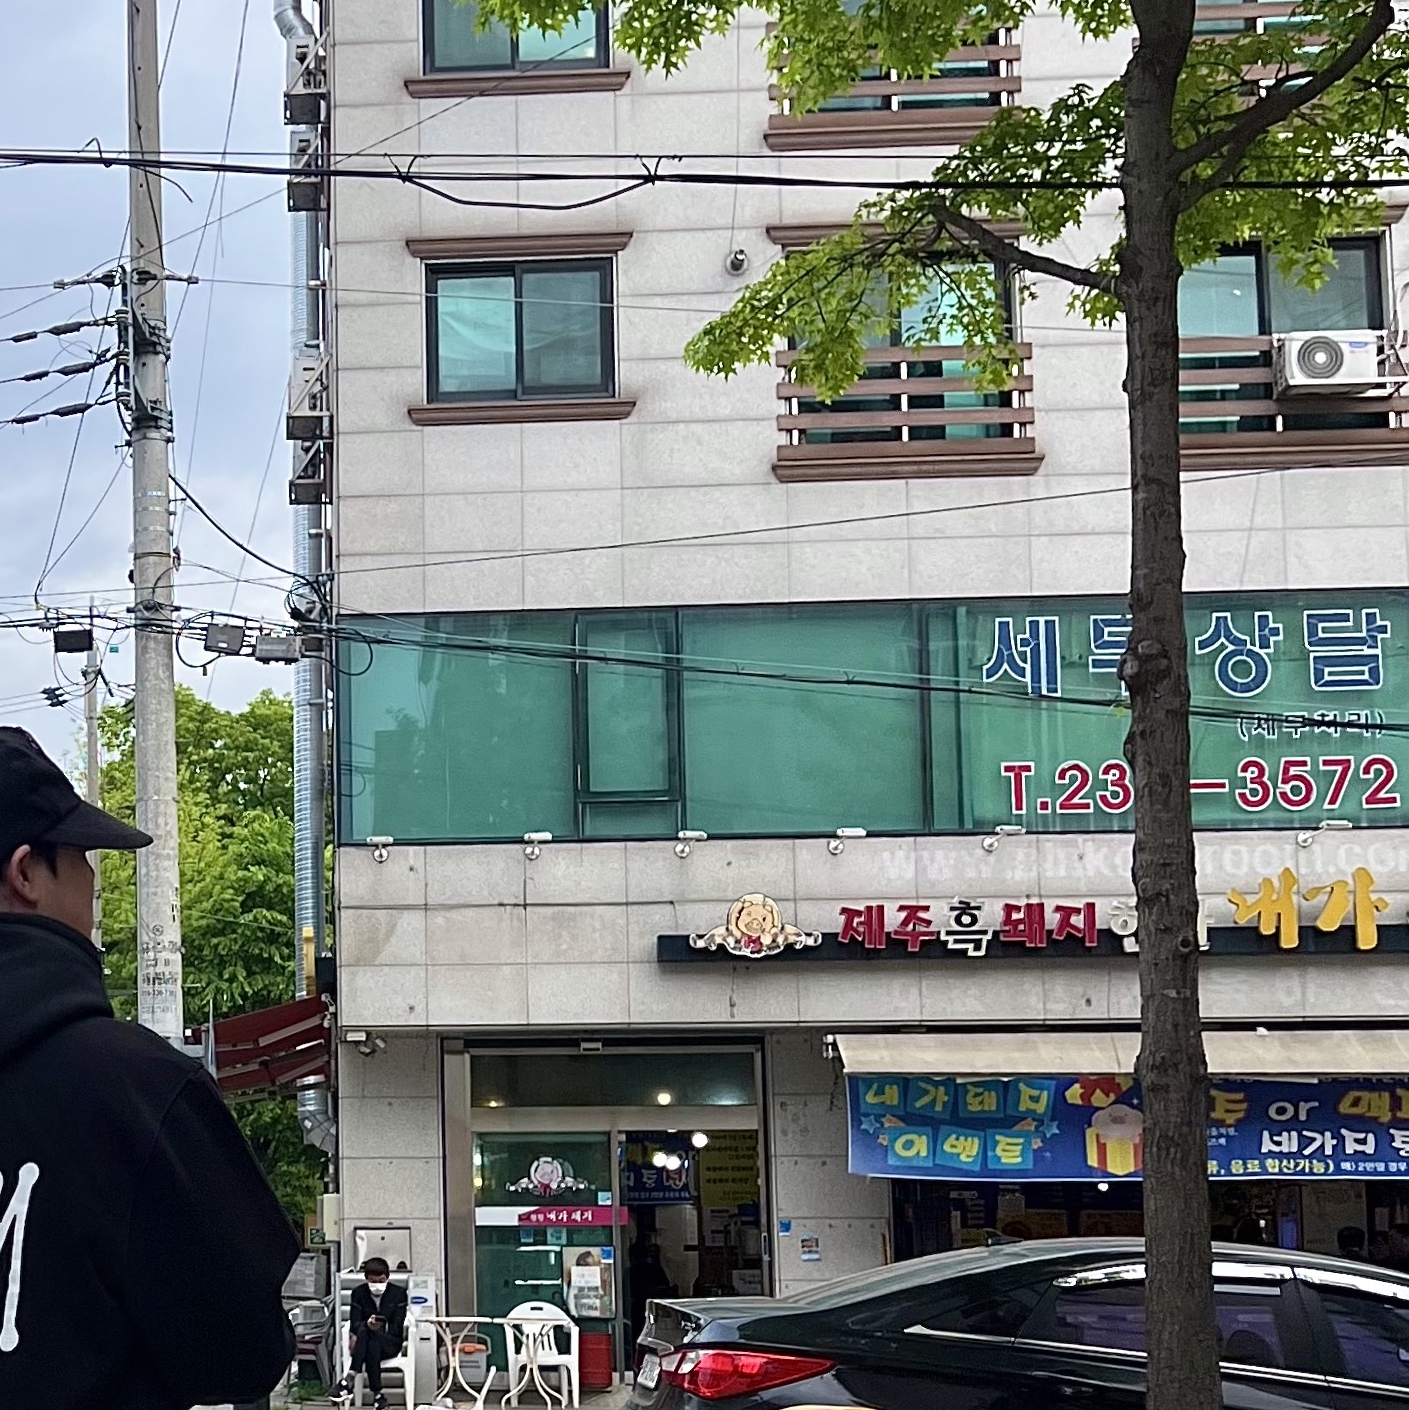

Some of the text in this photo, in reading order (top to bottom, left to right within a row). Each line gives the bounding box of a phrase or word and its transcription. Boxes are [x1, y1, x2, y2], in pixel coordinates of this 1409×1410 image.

[1000, 754, 1401, 814] T.23-3572
[1268, 1101, 1319, 1122] or
[894, 1133, 1025, 1164] 이벤트
